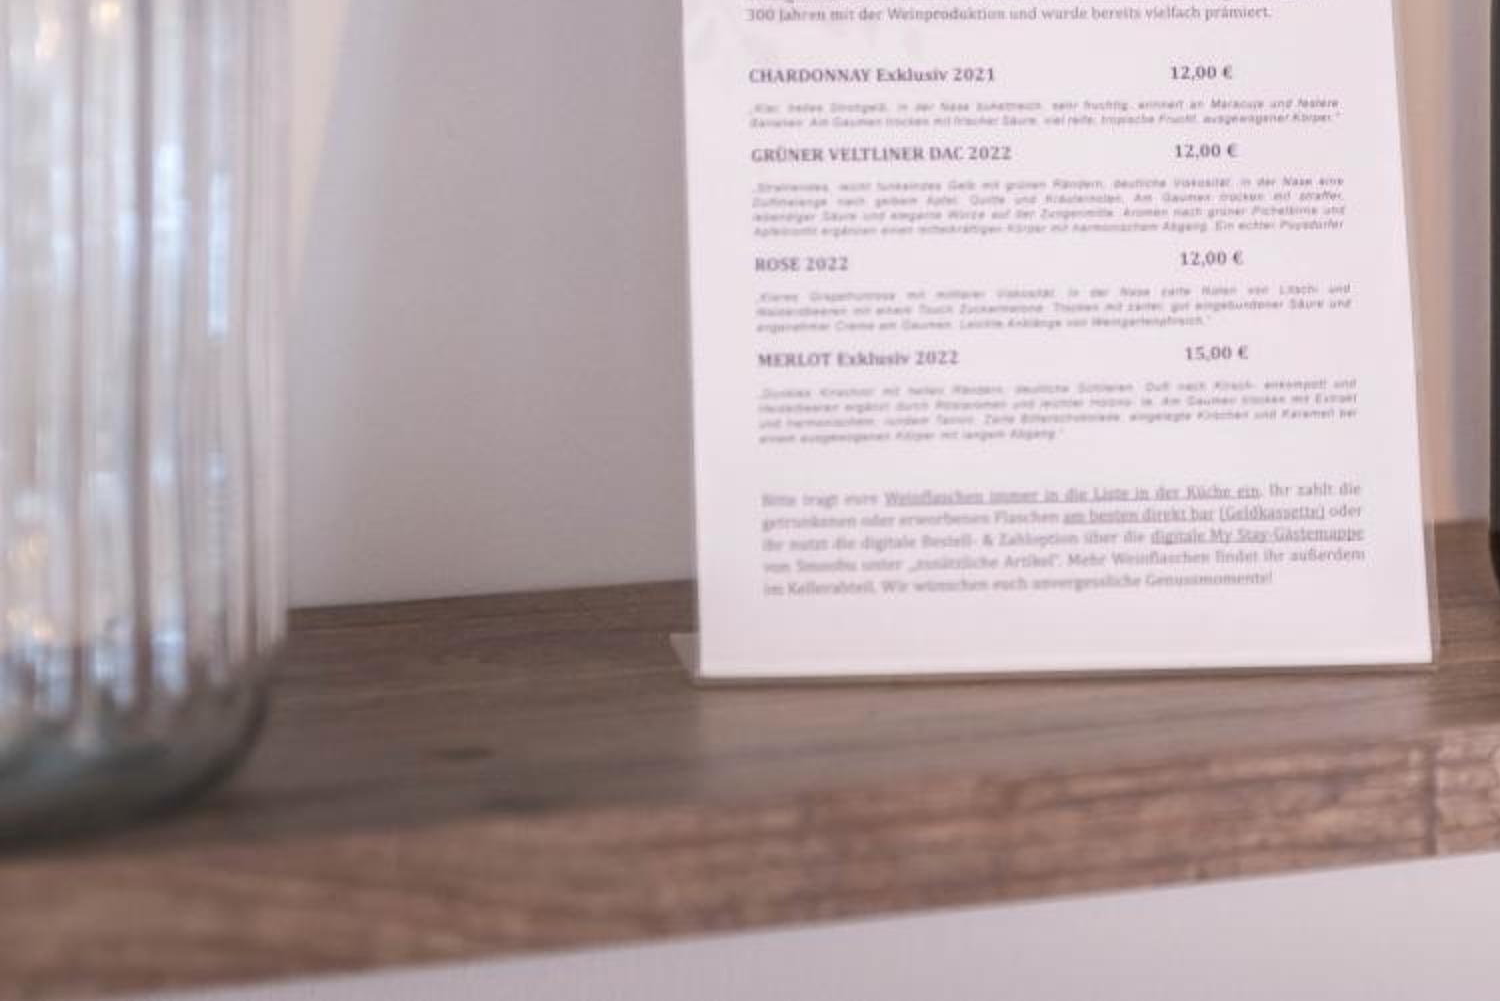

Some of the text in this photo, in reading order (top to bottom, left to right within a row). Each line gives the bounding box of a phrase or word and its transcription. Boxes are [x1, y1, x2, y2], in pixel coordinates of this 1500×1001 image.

[749, 65, 1233, 84] CHARDONNAY Exklusiv 2021 12,00 €
[751, 143, 1238, 162] GRÜNER VELTLINER DAC 2022 12,00 €
[755, 250, 1245, 272] ROSE 2022 12,00 €
[758, 345, 1249, 367] MERLOT Exklusiv 2022 15,00 €
